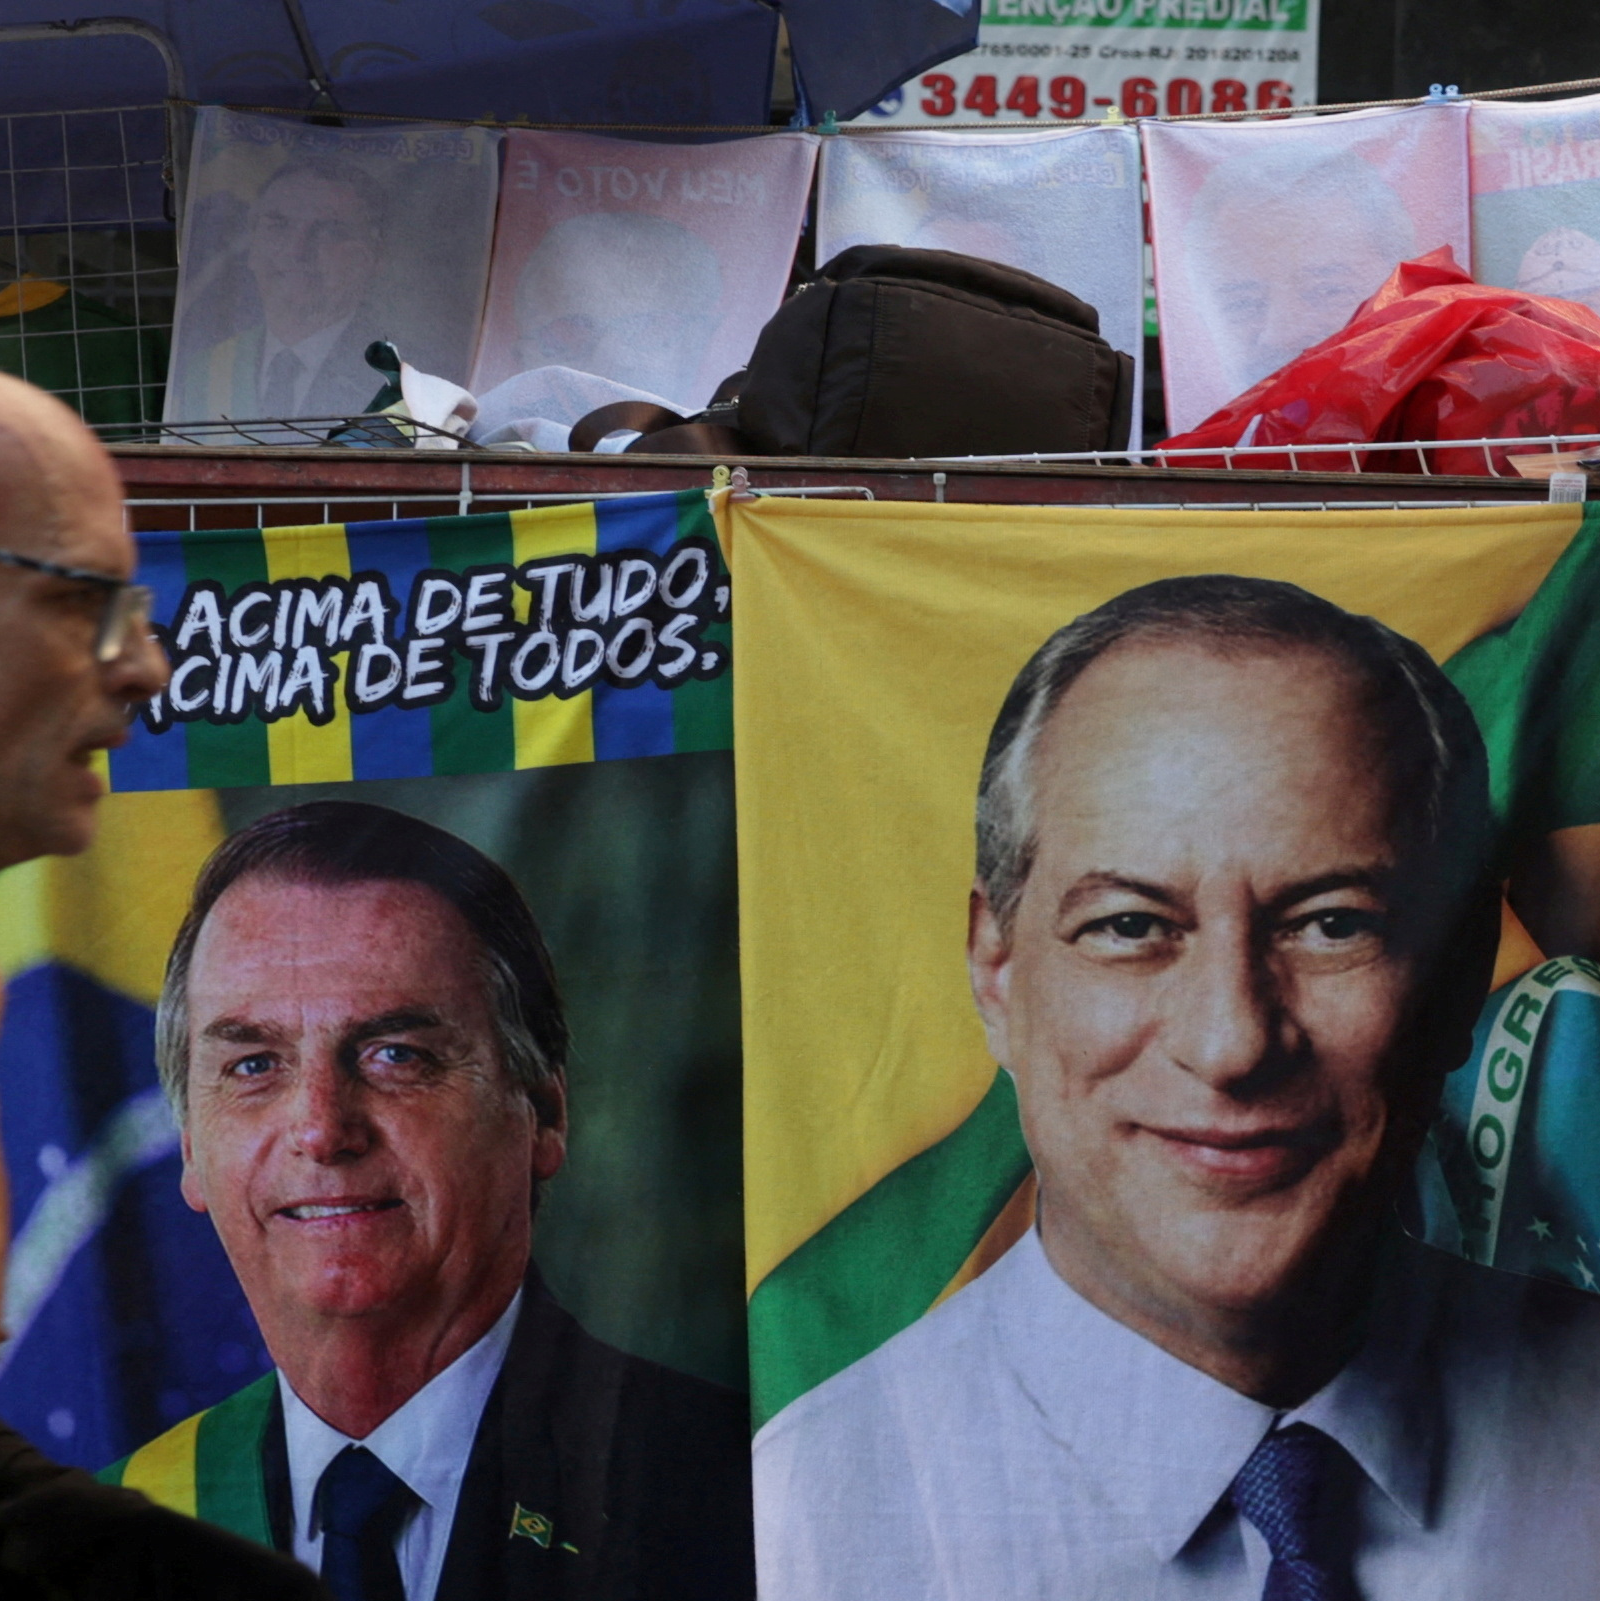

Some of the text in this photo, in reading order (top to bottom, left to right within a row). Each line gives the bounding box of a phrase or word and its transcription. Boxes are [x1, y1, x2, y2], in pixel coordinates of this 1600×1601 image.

[920, 73, 1294, 121] 3449-6086
[177, 548, 731, 657] ACIMA DE TUDO,
[354, 639, 446, 703] DE
[466, 614, 719, 702] TODOS.
